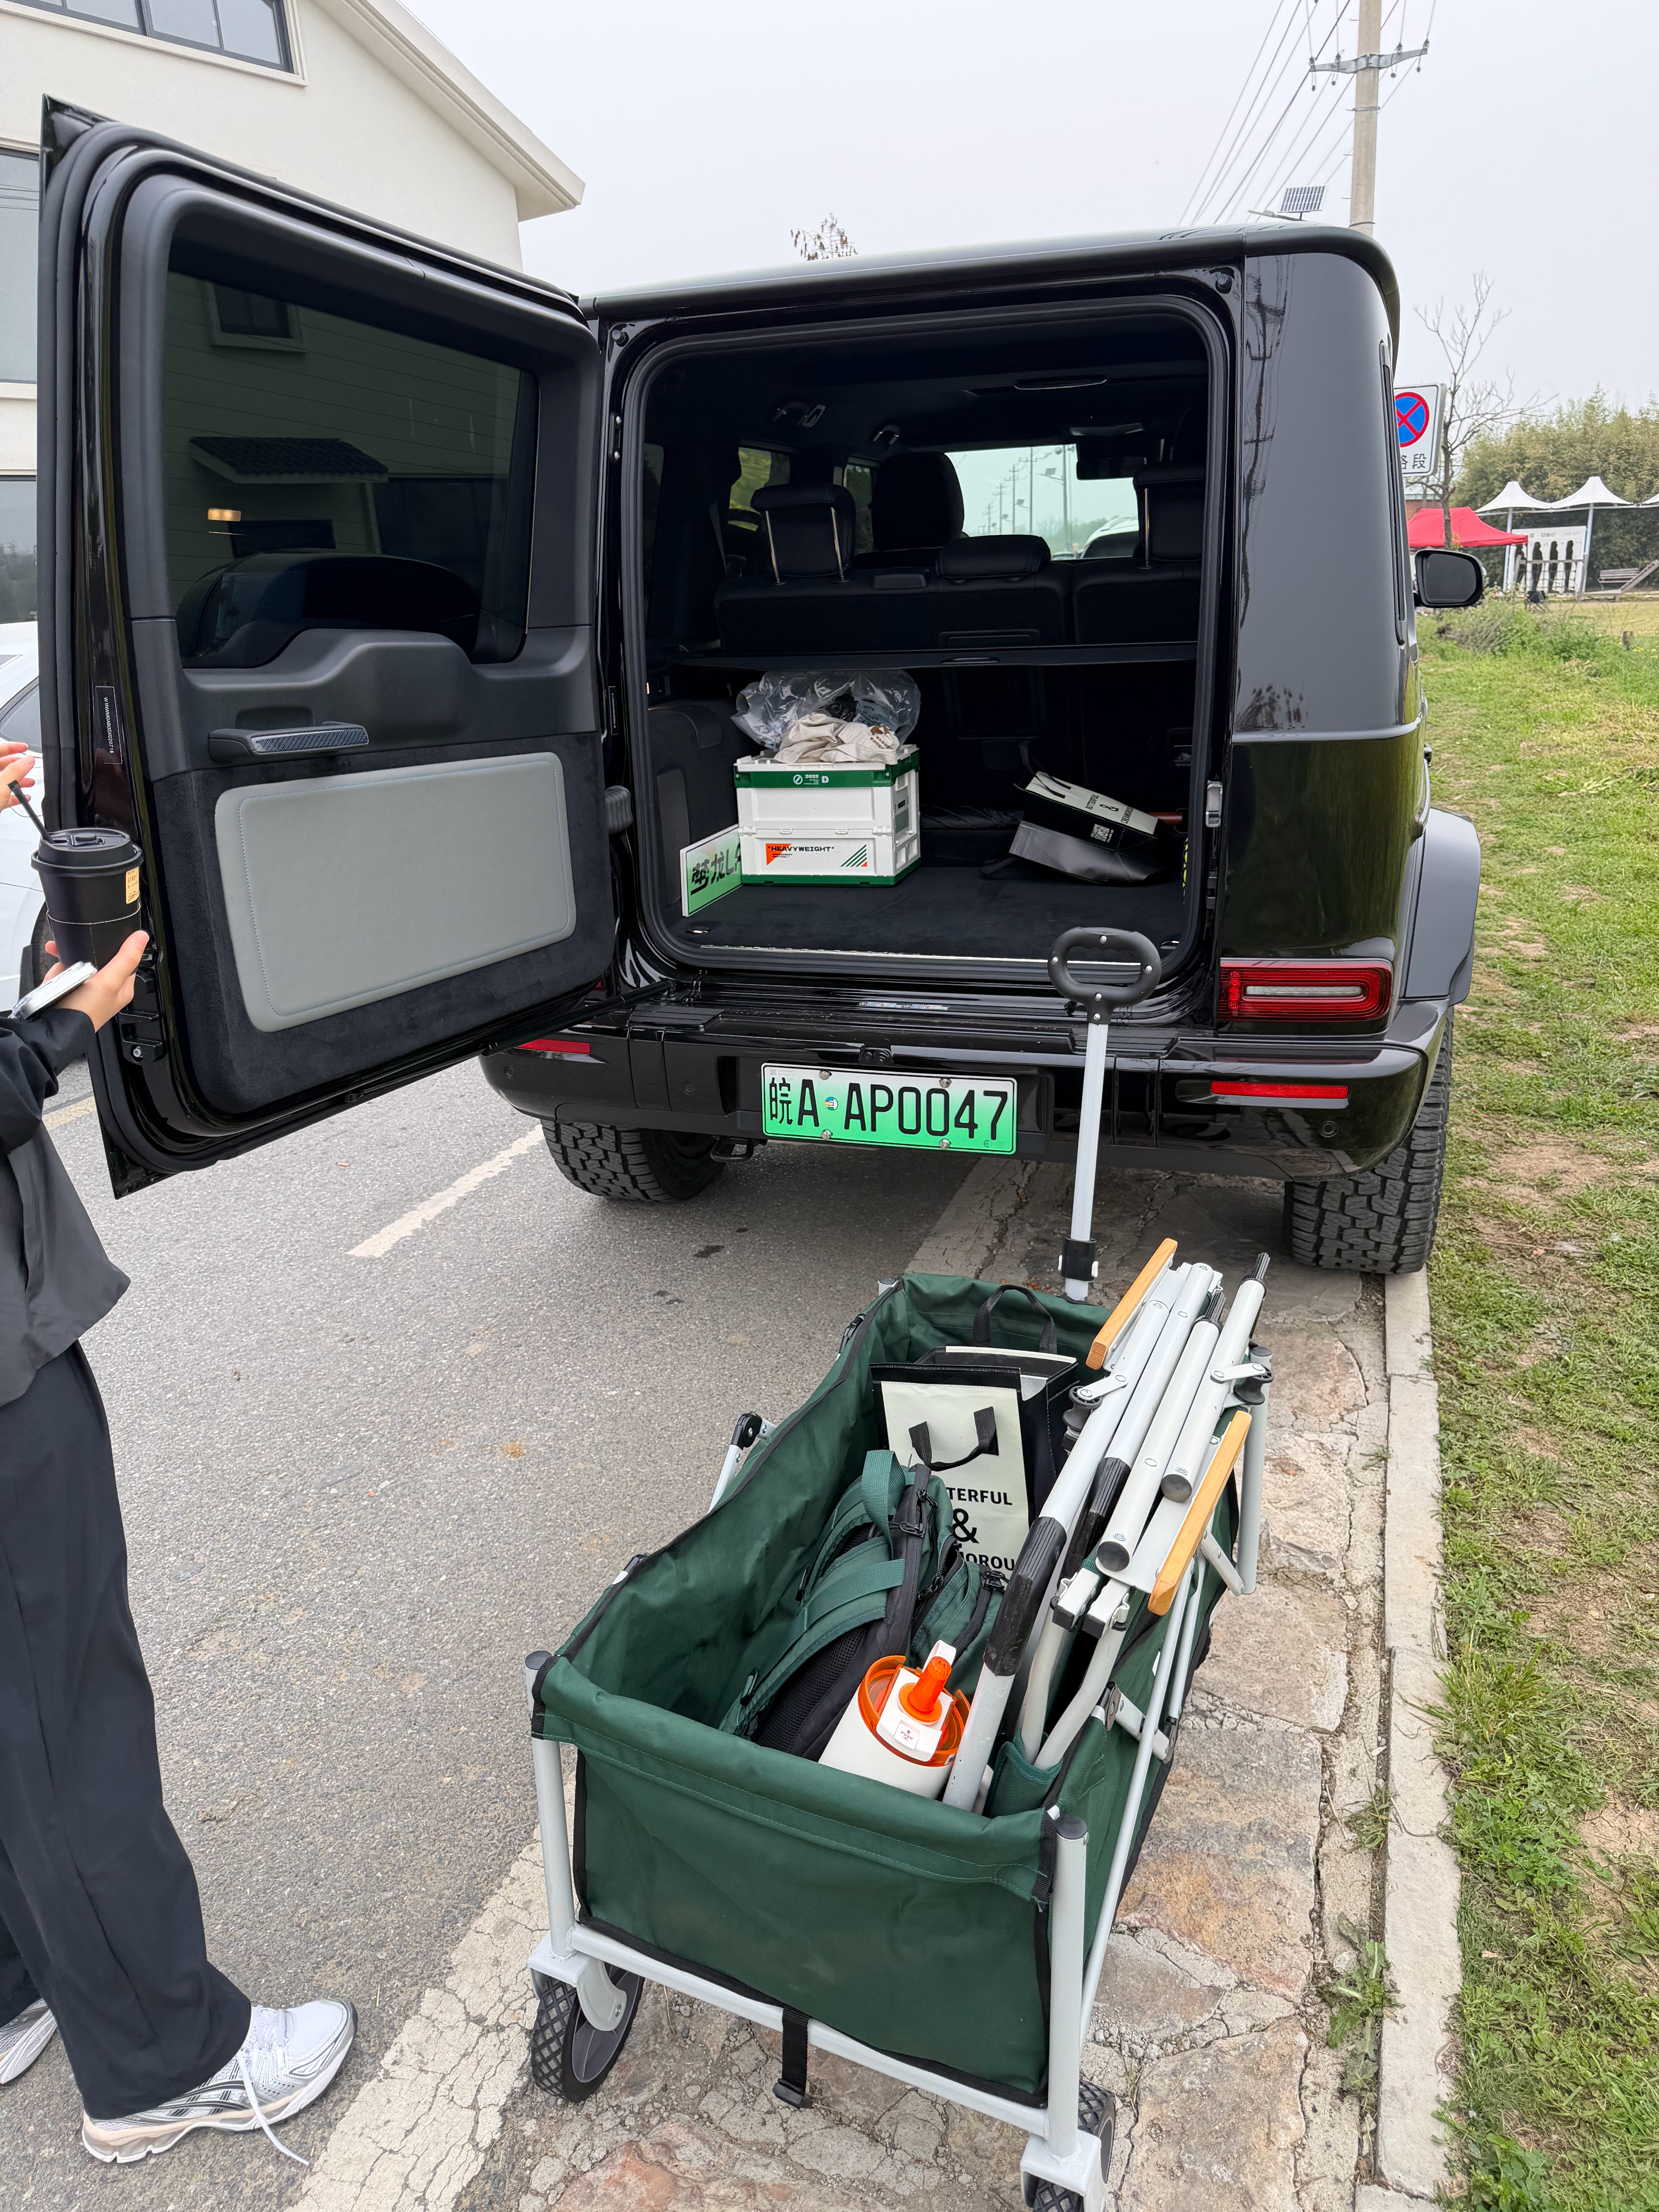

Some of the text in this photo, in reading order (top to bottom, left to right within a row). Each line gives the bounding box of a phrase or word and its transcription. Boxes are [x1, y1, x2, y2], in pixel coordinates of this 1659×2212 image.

[769, 1077, 1008, 1140] 皖A AP0047
[945, 1487, 1013, 1506] TERFUL
[952, 1508, 980, 1544] &
[960, 1551, 1015, 1571] OROU
[900, 1731, 913, 1740] PUSH
